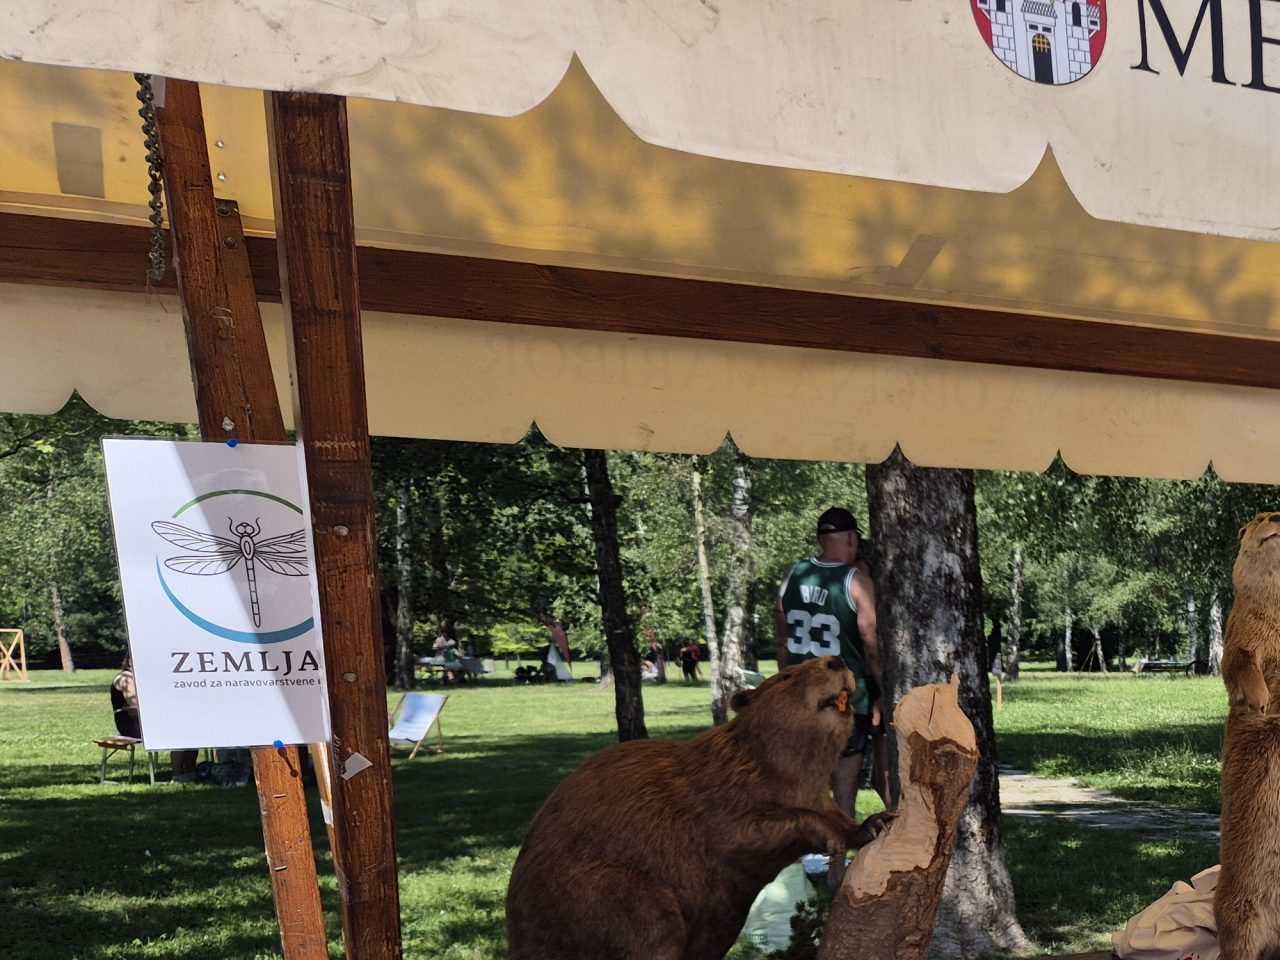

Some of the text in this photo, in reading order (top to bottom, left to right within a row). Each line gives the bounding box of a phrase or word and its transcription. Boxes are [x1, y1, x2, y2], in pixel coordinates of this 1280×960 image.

[799, 584, 829, 607] BIRD
[787, 609, 841, 657] 33
[171, 650, 320, 676] ZEMLJA
[173, 678, 207, 689] zavod
[210, 680, 223, 688] za
[225, 677, 316, 688] naravovarstvene
